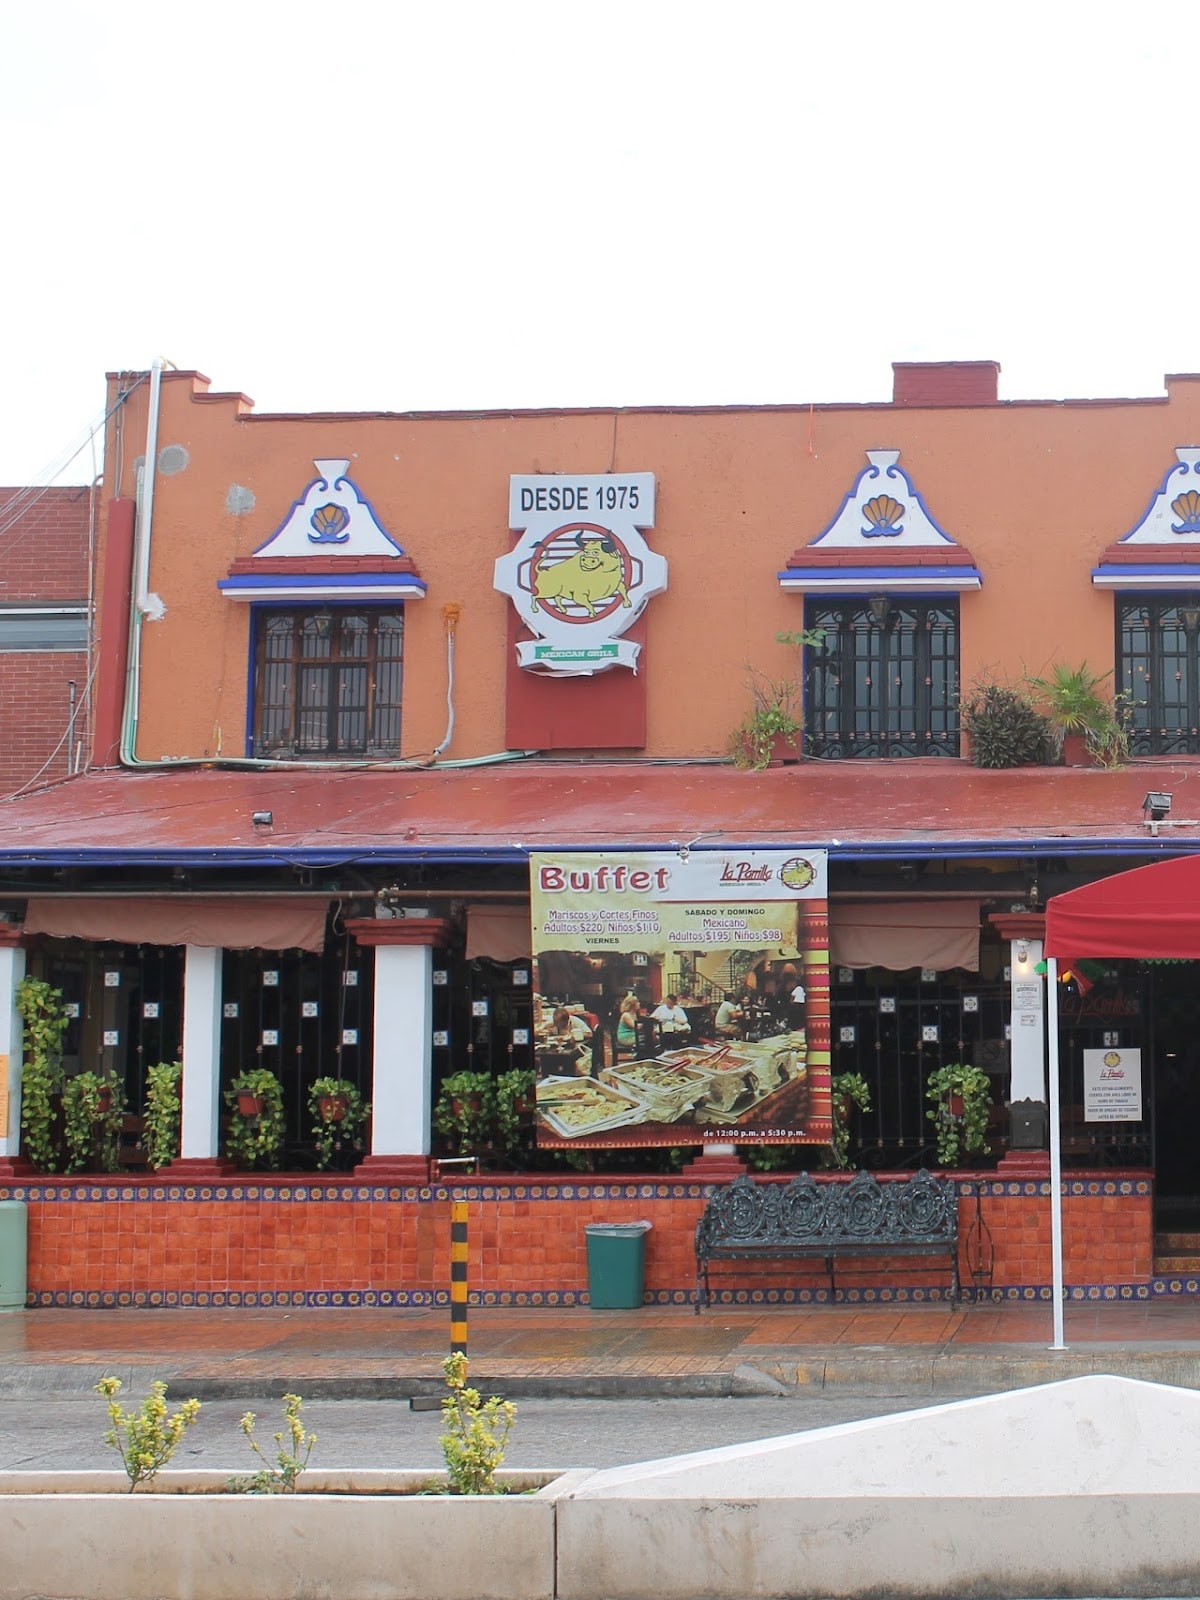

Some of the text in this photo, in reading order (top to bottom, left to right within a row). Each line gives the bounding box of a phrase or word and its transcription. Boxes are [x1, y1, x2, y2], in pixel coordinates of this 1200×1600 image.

[520, 485, 640, 512] DESDE 1975
[540, 650, 585, 659] MEXICAN
[540, 866, 670, 891] Buffet
[549, 909, 657, 921] Mariscos y Cortes Finos
[684, 908, 766, 916] SABADO Y DOMINGO
[544, 921, 660, 933] Adultos $220 Niños $110
[703, 918, 746, 928] Mexicano
[669, 930, 781, 941] Adultos $195 Niños $98
[703, 1129, 714, 1137] de
[716, 1129, 739, 1137] 12:00
[740, 1130, 759, 1138] p.m.
[767, 1129, 786, 1137] 5:30
[787, 1130, 806, 1138] p.m.
